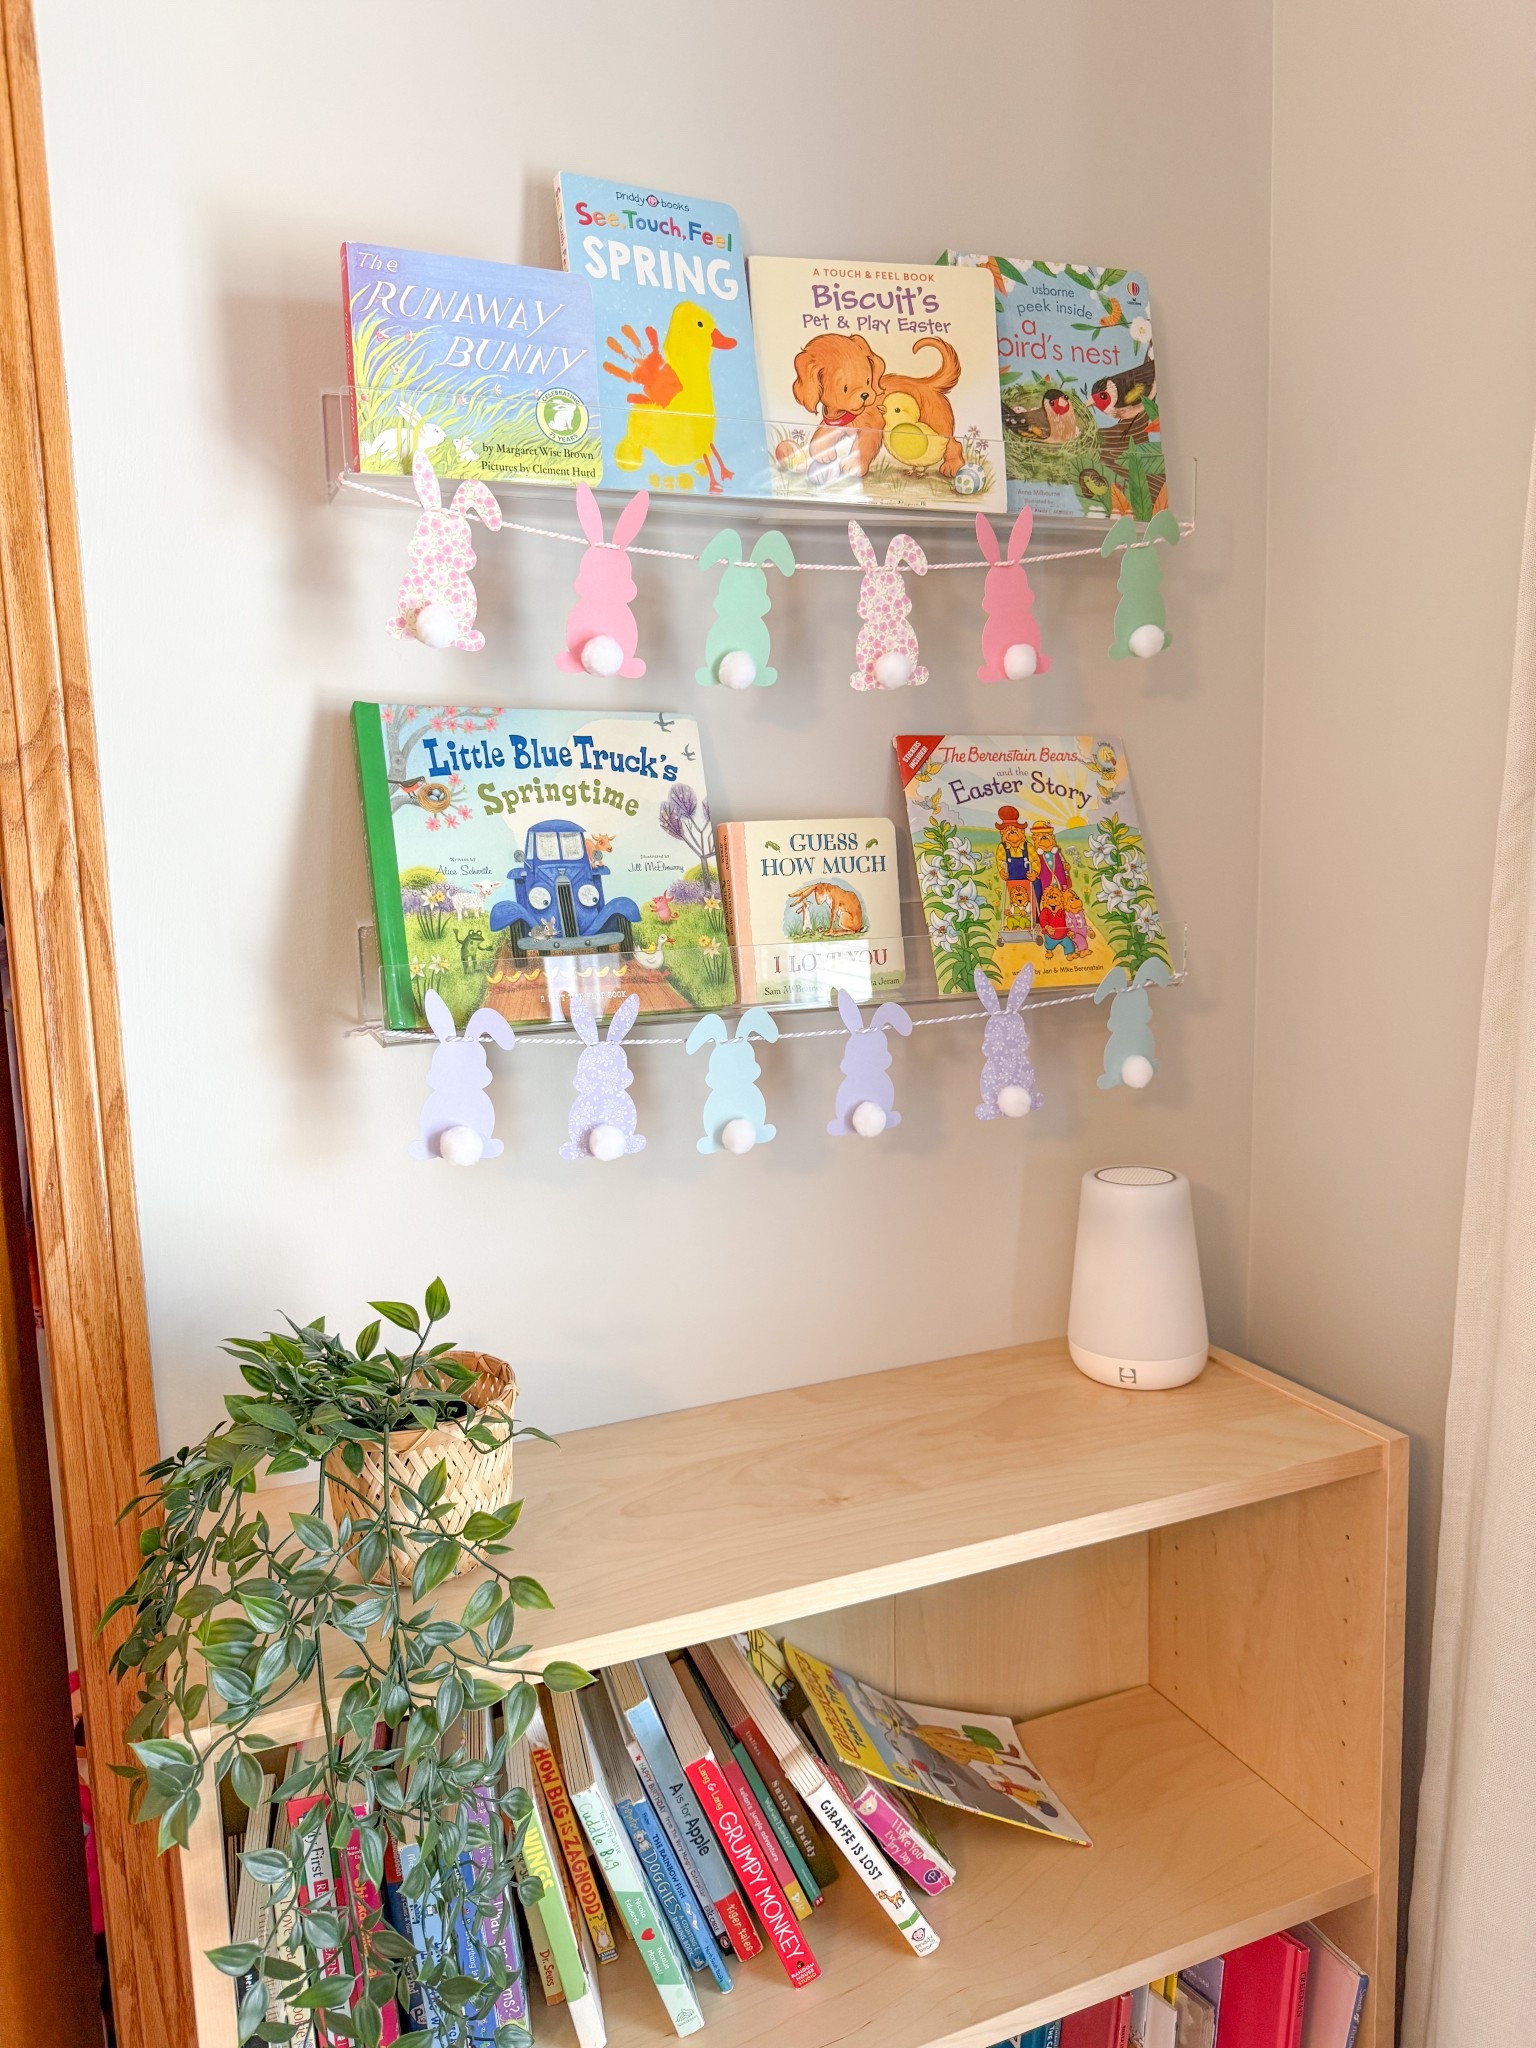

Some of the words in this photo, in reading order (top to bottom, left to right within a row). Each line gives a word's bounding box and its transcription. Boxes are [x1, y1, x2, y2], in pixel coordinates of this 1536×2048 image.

[615, 191, 646, 207] priddy
[661, 198, 690, 212] books
[575, 202, 626, 230] See,
[622, 209, 687, 241] Touch,
[688, 221, 732, 252] Feel
[357, 251, 399, 273] The
[583, 235, 739, 301] SPRING
[813, 268, 820, 276] A
[823, 268, 861, 279] TOUCH
[865, 271, 872, 279] &
[875, 271, 900, 280] FEEL
[904, 273, 935, 282] BOOK
[811, 282, 940, 315] Biscuit's
[1032, 283, 1075, 298] usborne
[360, 280, 566, 339] RUNAWAY
[1017, 299, 1051, 316] peek
[1056, 301, 1093, 320] inside
[802, 314, 829, 330] Pet
[837, 316, 850, 329] &
[857, 314, 891, 334] Play
[898, 318, 952, 335] Easter
[1021, 319, 1036, 336] a
[436, 336, 589, 386] BUNNY
[1071, 346, 1120, 366] nest
[542, 389, 580, 405] CELEBRATING
[557, 434, 579, 442] YEARS
[482, 443, 494, 455] by
[496, 444, 538, 457] Margaret
[539, 447, 562, 457] Wise
[564, 449, 594, 460] Brown
[481, 461, 518, 472] Pictures
[519, 463, 531, 474] by
[533, 465, 570, 476] Clement
[572, 467, 596, 478] Hurd
[422, 737, 506, 777] Little
[509, 734, 573, 770] Blue
[573, 735, 679, 782] Truck's
[938, 747, 966, 763] The
[968, 747, 1037, 763] Berenstain
[1039, 748, 1078, 762] Bears
[996, 769, 1013, 777] and
[1015, 767, 1029, 777] the
[477, 776, 640, 817] Springtime
[948, 777, 1023, 805] Easter
[1030, 771, 1093, 809] Story
[789, 833, 859, 852] GUESS
[761, 857, 815, 877] HOW
[823, 855, 886, 874] MUCH
[774, 956, 781, 974] I
[764, 987, 781, 996] Sam
[878, 978, 900, 986] Jeram
[607, 990, 627, 999] BOOK
[533, 1748, 560, 1784] HOW
[698, 1763, 711, 1785] Lang
[669, 1782, 684, 1796] A
[707, 1783, 716, 1792] &
[546, 1785, 570, 1819] BIG
[676, 1794, 684, 1804] is
[680, 1802, 693, 1818] for
[711, 1790, 724, 1811] Lang
[638, 1762, 653, 1785] HAPPY
[648, 1783, 667, 1814] BIRTHDAY
[681, 1851, 692, 1871] Hungry
[690, 1870, 706, 1897] Caterpillar
[771, 1779, 791, 1812] Sunny
[789, 1812, 798, 1823] &
[795, 1825, 816, 1858] Daddy
[892, 1818, 899, 1828] I
[578, 1803, 606, 1846] Cuddle
[600, 1848, 620, 1871] Bug
[685, 1817, 711, 1857] Apple
[749, 1810, 763, 1831] jungle
[760, 1831, 779, 1863] adventure
[525, 1826, 554, 1889] WINGS
[719, 1812, 768, 1885] GRUMPY
[899, 1851, 912, 1866] Day
[310, 1847, 325, 1878] First
[652, 1834, 661, 1849] THE
[659, 1848, 677, 1881] RAINBOW
[675, 1880, 687, 1899] FISH
[859, 1854, 882, 1881] LOST
[562, 1836, 604, 1922] ZAGNODD?
[642, 1849, 681, 1915] DOGGIES
[624, 1899, 640, 1926] Edwards
[634, 1898, 647, 1919] Nicola
[682, 1920, 697, 1946] COUNTING
[726, 1903, 742, 1928] tiger
[738, 1927, 754, 1952] tales
[755, 1885, 805, 1959] MONKEY
[671, 1916, 684, 1940] BARKING
[682, 1940, 694, 1956] BOOK
[539, 1949, 551, 1964] Dr.
[647, 1949, 663, 1976] Marshall
[656, 1946, 670, 1969] Natalie
[544, 1963, 555, 1987] Seuss
[791, 1962, 815, 1979] RANDOM
[796, 1968, 815, 1981] HOUSE
[798, 1973, 817, 1986] STUDIO
